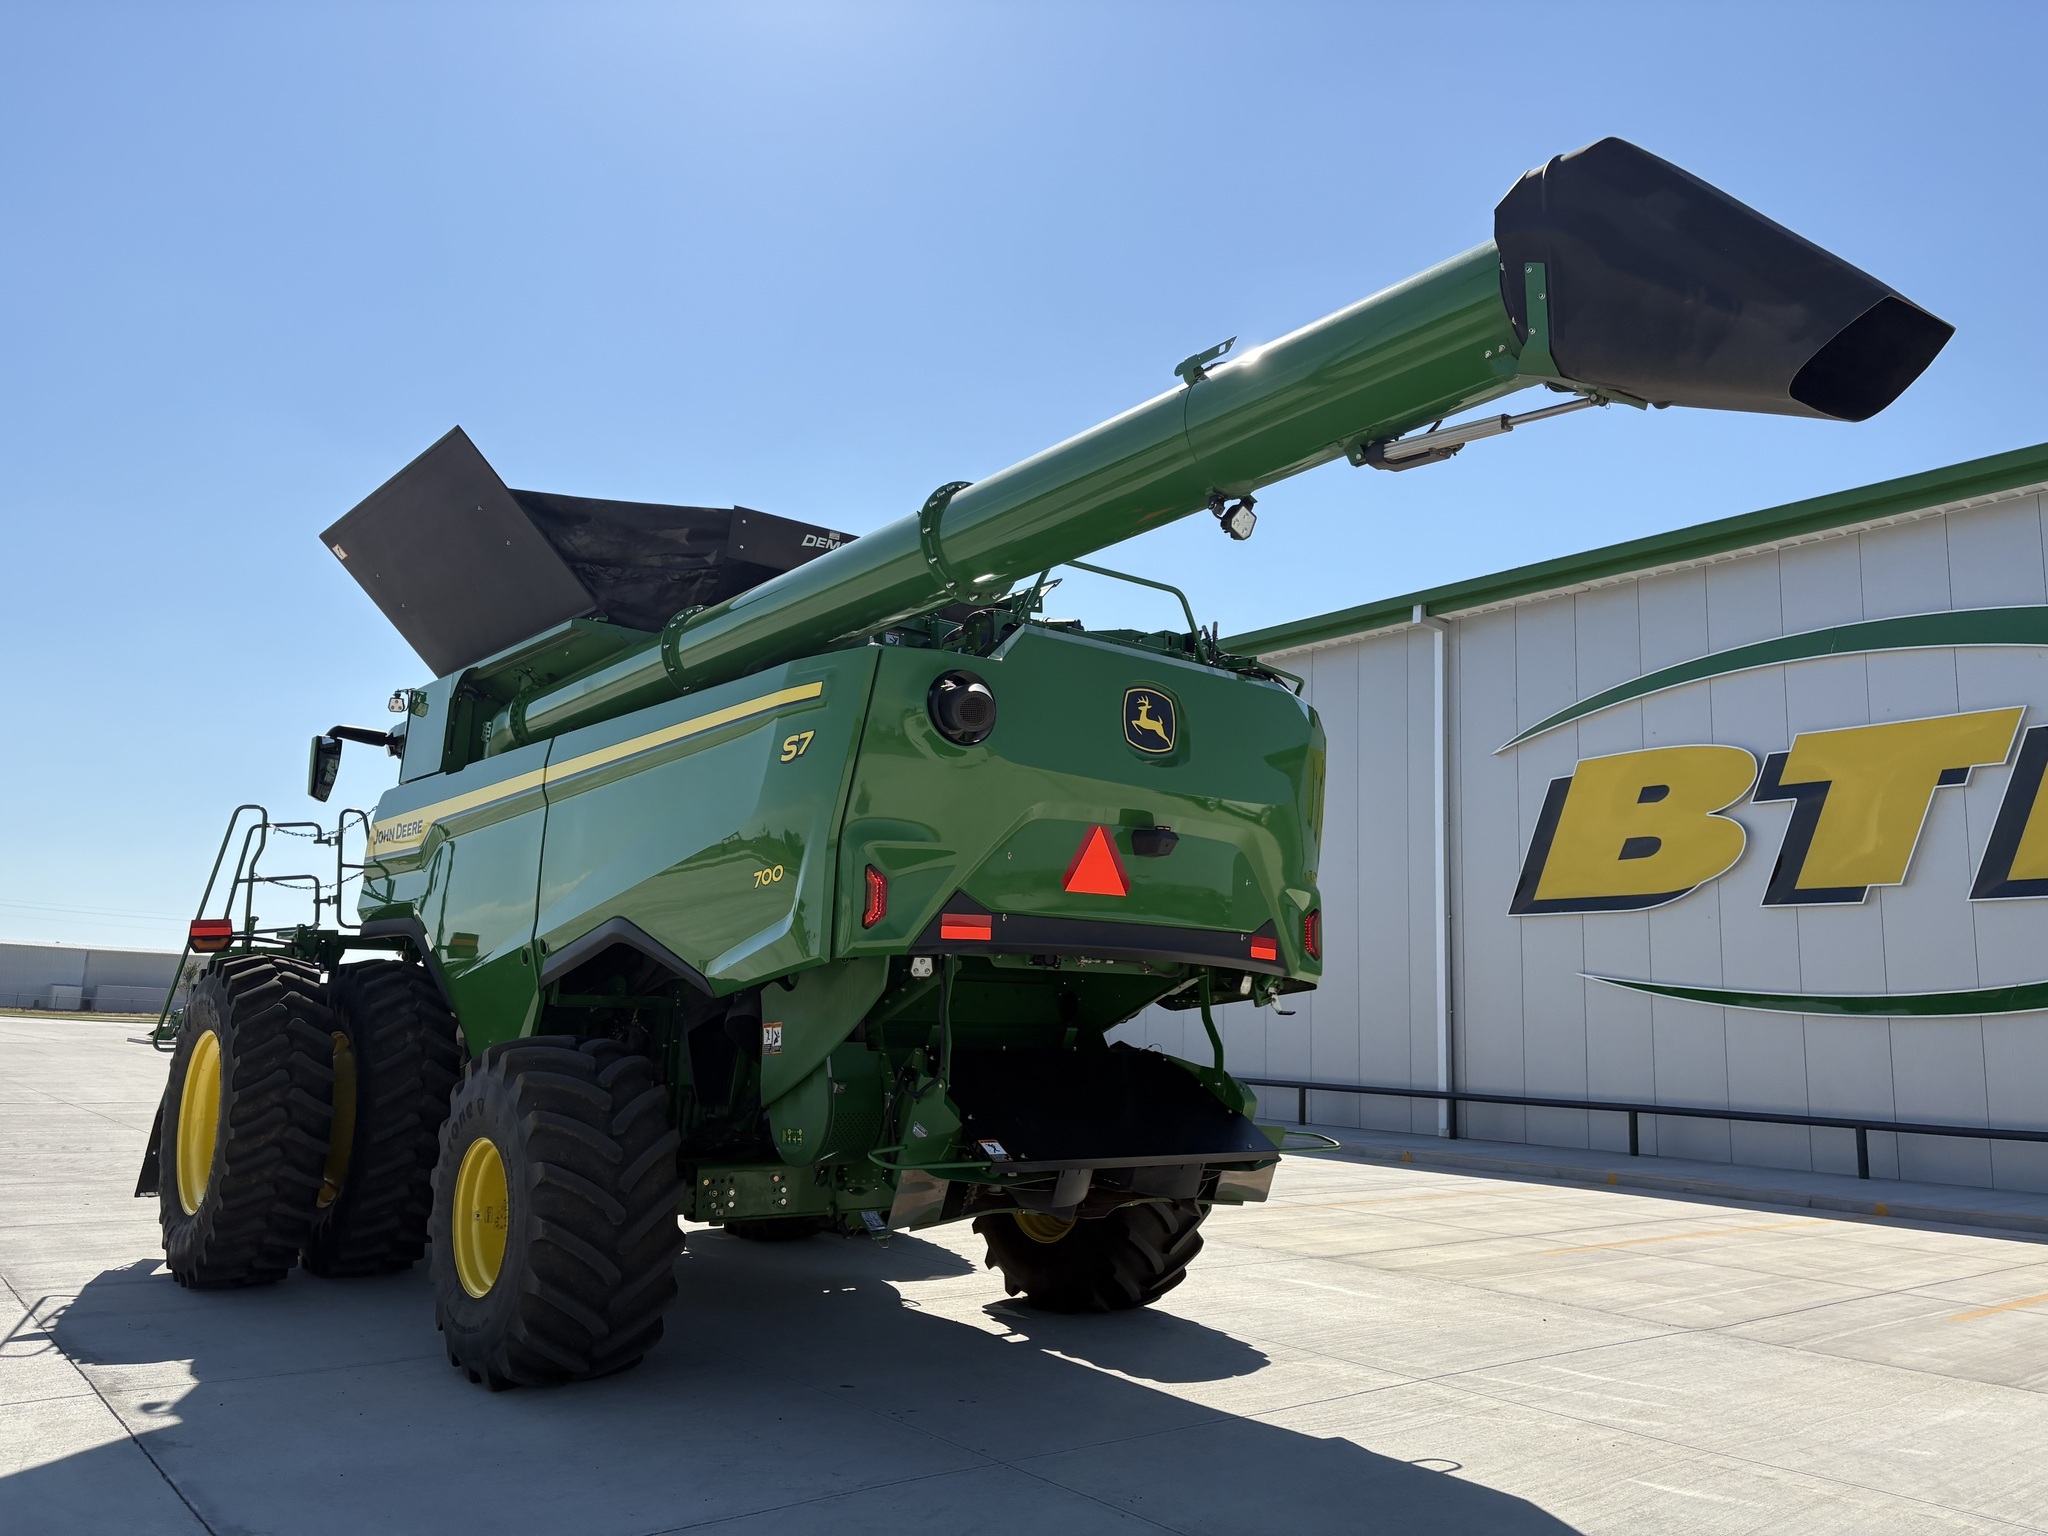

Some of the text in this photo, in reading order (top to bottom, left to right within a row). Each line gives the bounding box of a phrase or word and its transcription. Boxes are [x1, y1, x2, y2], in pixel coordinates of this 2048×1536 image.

[780, 729, 816, 764] S7
[373, 819, 423, 845] JOHN DEERE
[753, 864, 784, 889] 700
